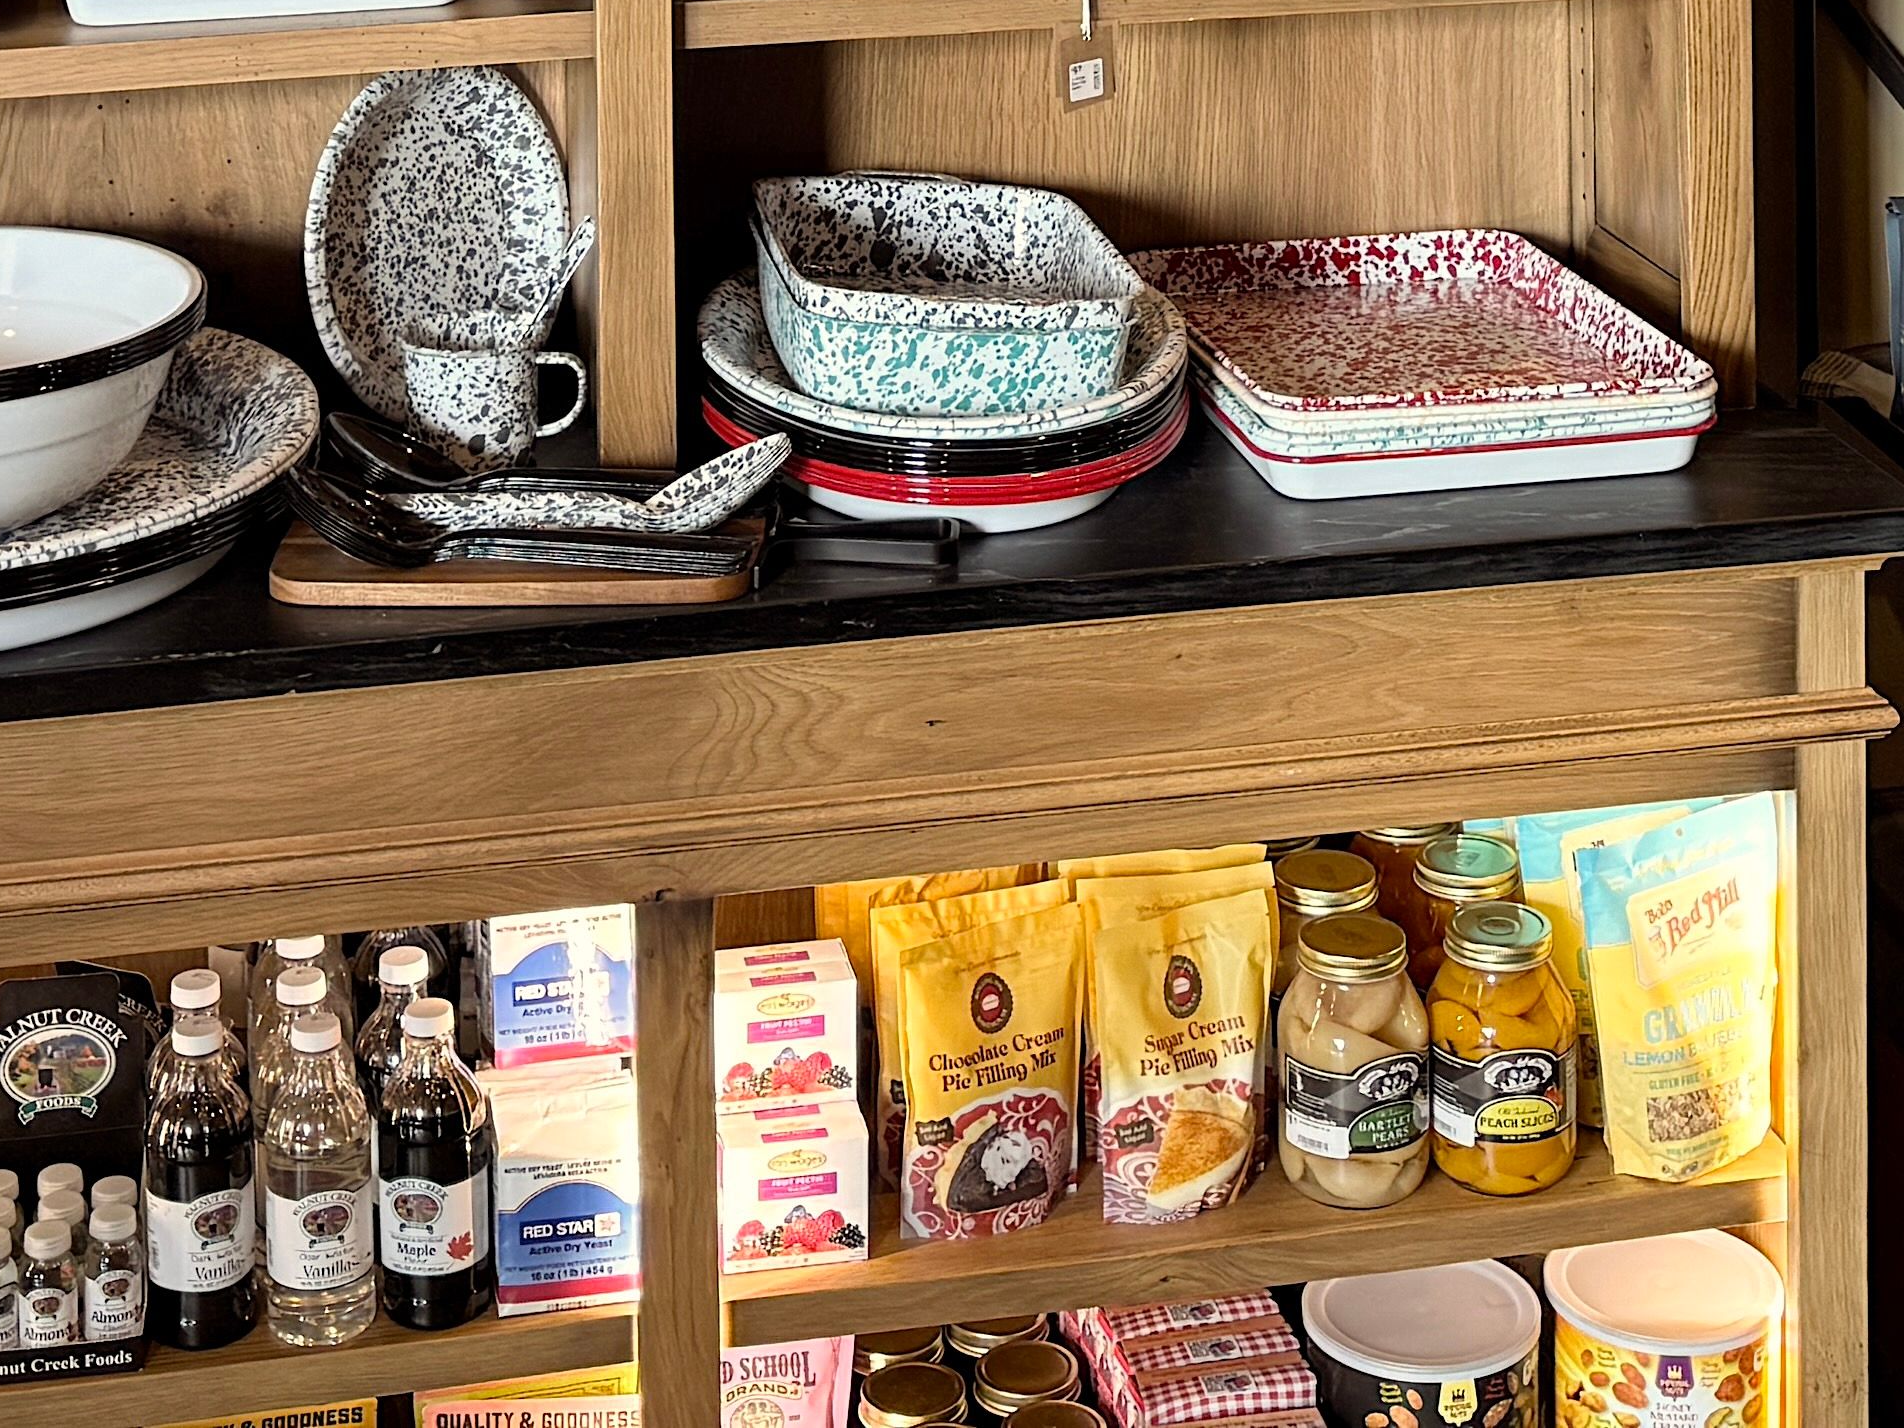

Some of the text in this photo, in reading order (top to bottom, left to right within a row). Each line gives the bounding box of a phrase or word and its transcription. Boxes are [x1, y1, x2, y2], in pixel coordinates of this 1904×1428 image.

[65, 1008, 129, 1048] CREEK
[1144, 1015, 1246, 1060] Sugar Cream
[929, 1027, 1065, 1073] Chocolate Cream
[1140, 1035, 1255, 1077] Pie Filling Mix
[1623, 1048, 1685, 1067] LEMON
[942, 1049, 1057, 1092] Pie Filling Mix
[35, 1096, 82, 1108] FOODS
[1480, 1111, 1555, 1129] PEACH SLICES
[1372, 1127, 1409, 1142] PEARS
[523, 1219, 593, 1239] RED STAR
[397, 1241, 437, 1257] Maple
[529, 1239, 613, 1256] Active Dry Yeast
[196, 1259, 238, 1280] Vanilla
[303, 1259, 344, 1279] Vanilla
[31, 1356, 80, 1375] Creek
[84, 1350, 133, 1368] Foods
[740, 1351, 816, 1386] SCHOOL
[261, 1407, 363, 1428] GOODNESS
[437, 1410, 640, 1428] QUALITY & GOODNESS
